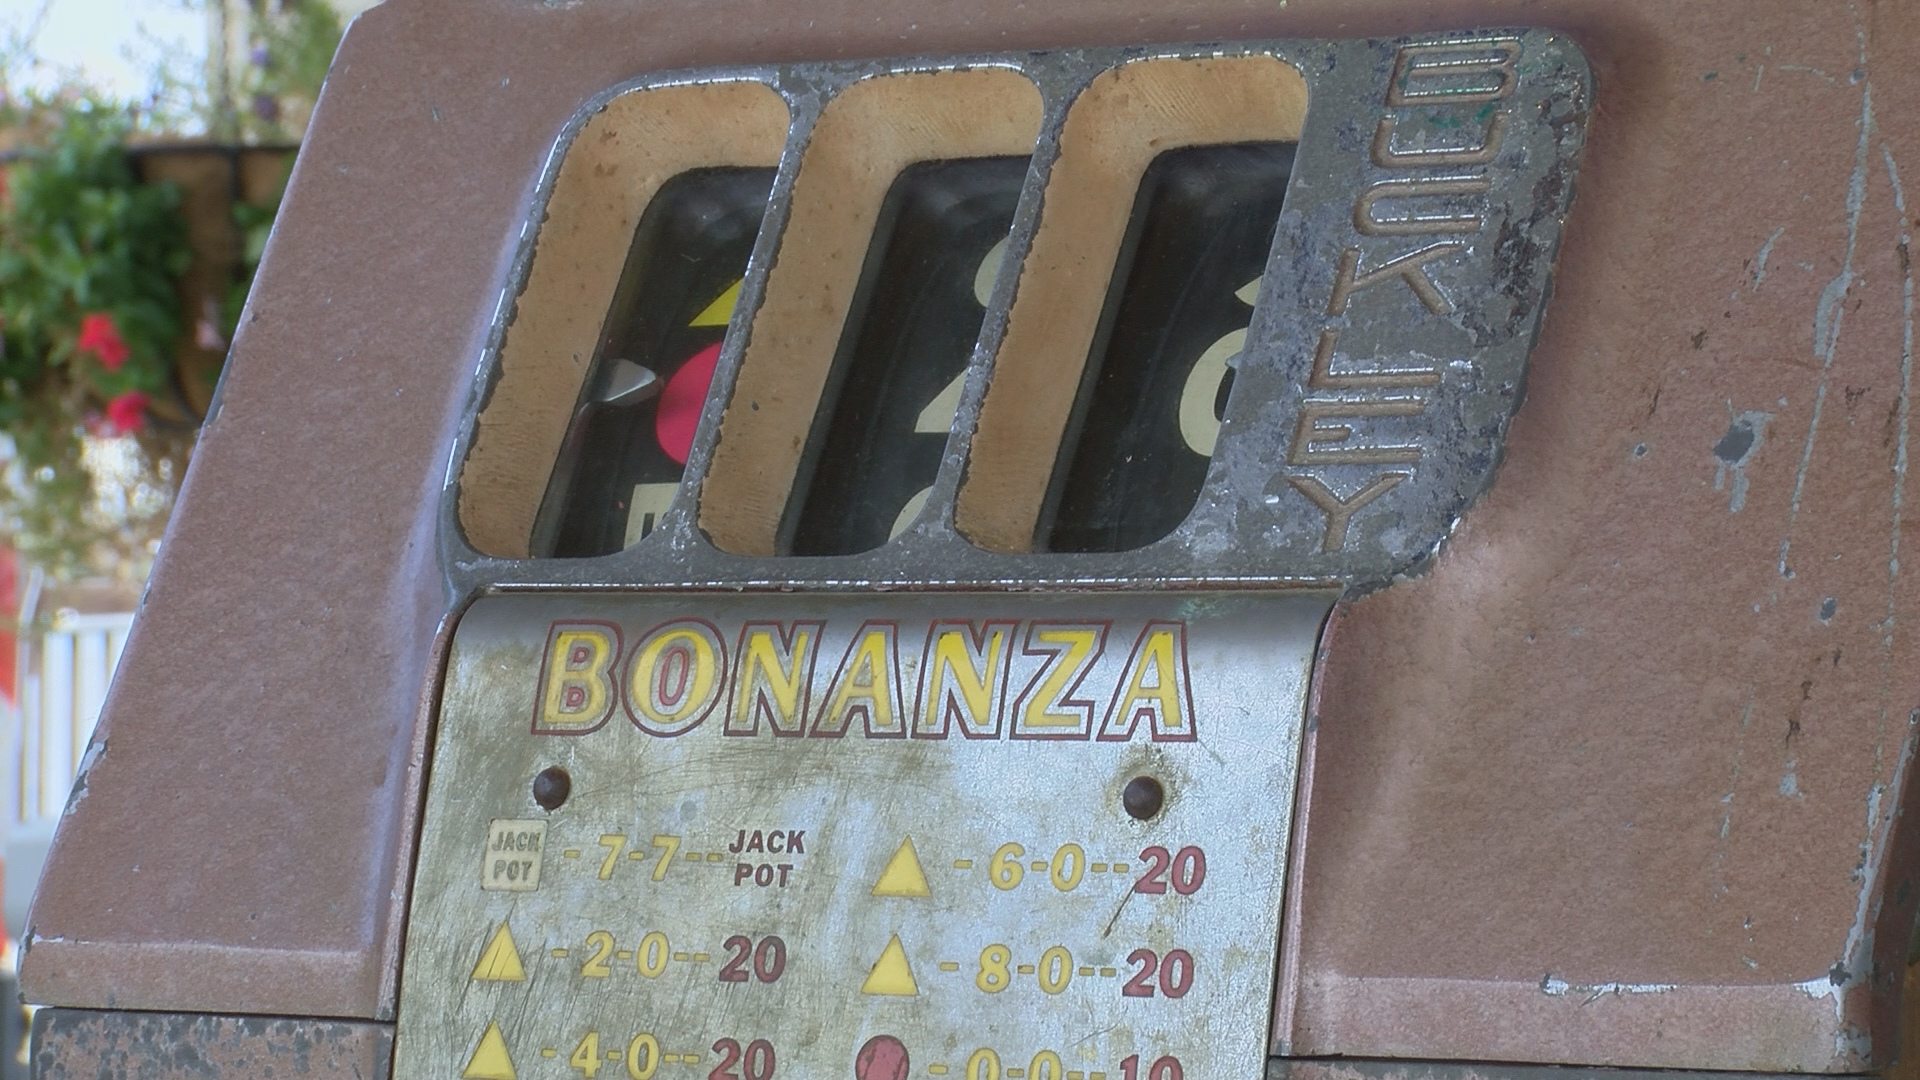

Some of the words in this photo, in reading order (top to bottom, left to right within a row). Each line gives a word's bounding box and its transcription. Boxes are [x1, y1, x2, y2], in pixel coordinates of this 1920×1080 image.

[531, 617, 1198, 742] BONANZA
[491, 831, 541, 852] JACK
[729, 829, 806, 854] JACK
[493, 859, 533, 882] POT
[733, 863, 794, 888] POT
[1134, 845, 1207, 896] 20
[718, 935, 788, 984] 20
[1122, 948, 1195, 999] 20
[708, 1037, 776, 1080] 20
